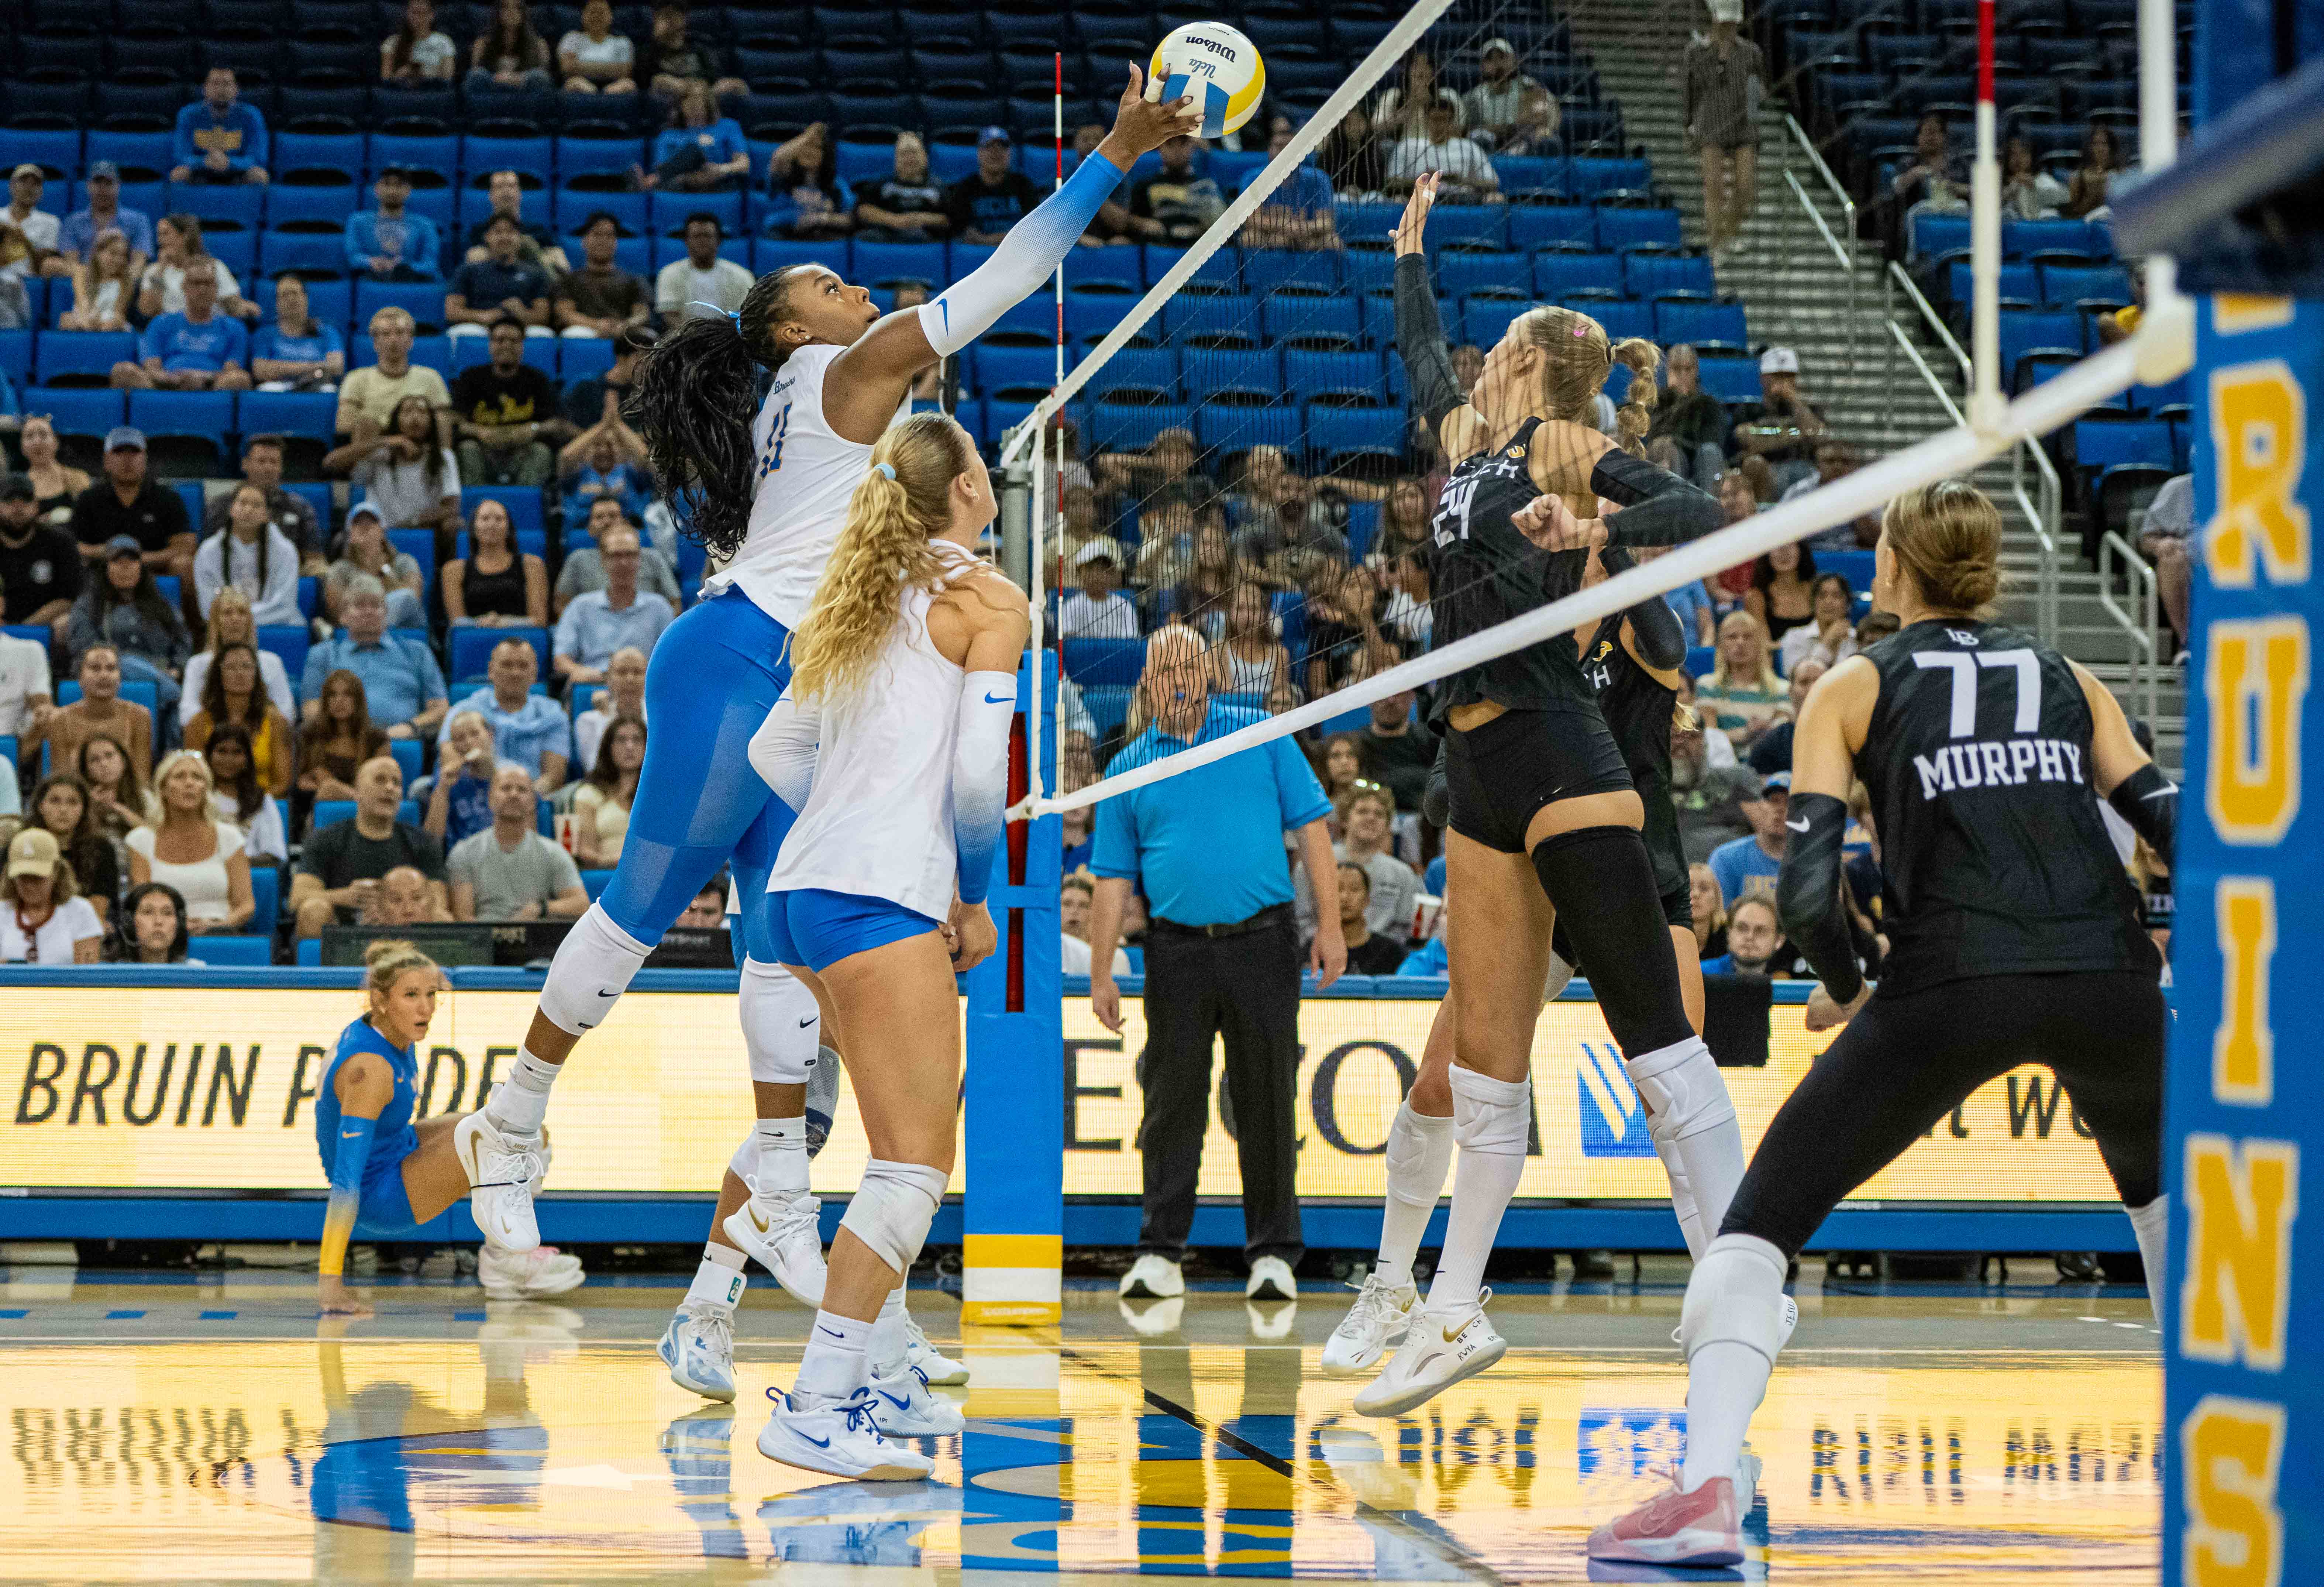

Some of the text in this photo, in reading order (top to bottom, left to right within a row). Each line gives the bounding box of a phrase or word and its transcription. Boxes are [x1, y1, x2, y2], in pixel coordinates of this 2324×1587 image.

[1185, 36, 1236, 63] Wilson
[773, 376, 796, 395] Bruins
[1432, 479, 1480, 549] 24
[1911, 648, 2042, 739] 77
[1913, 739, 2084, 801] MURPHY
[2181, 294, 2312, 1587] RUINS
[16, 1044, 517, 1127] BRUIN PDE
[1456, 1332, 1468, 1344] BE
